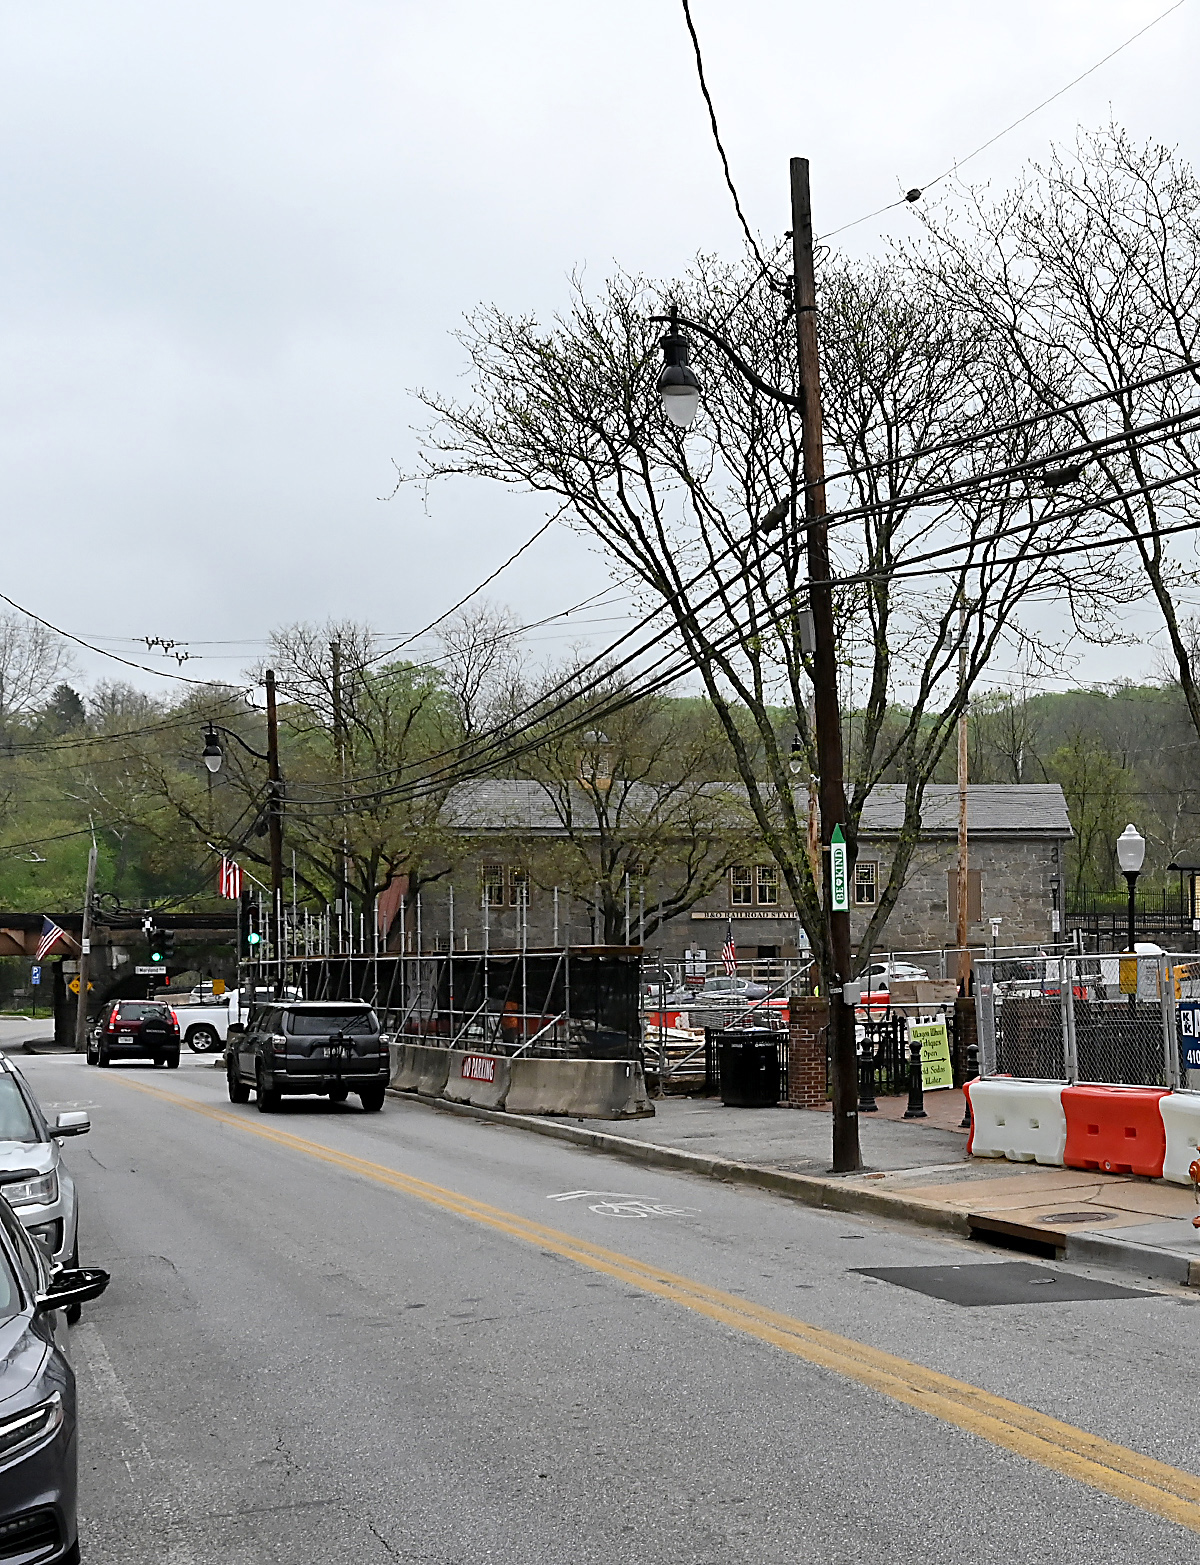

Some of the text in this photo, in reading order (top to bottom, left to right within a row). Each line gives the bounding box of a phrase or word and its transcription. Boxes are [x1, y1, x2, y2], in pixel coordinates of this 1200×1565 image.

[835, 849, 844, 901] BE KIND
[923, 1050, 938, 1059] Open
